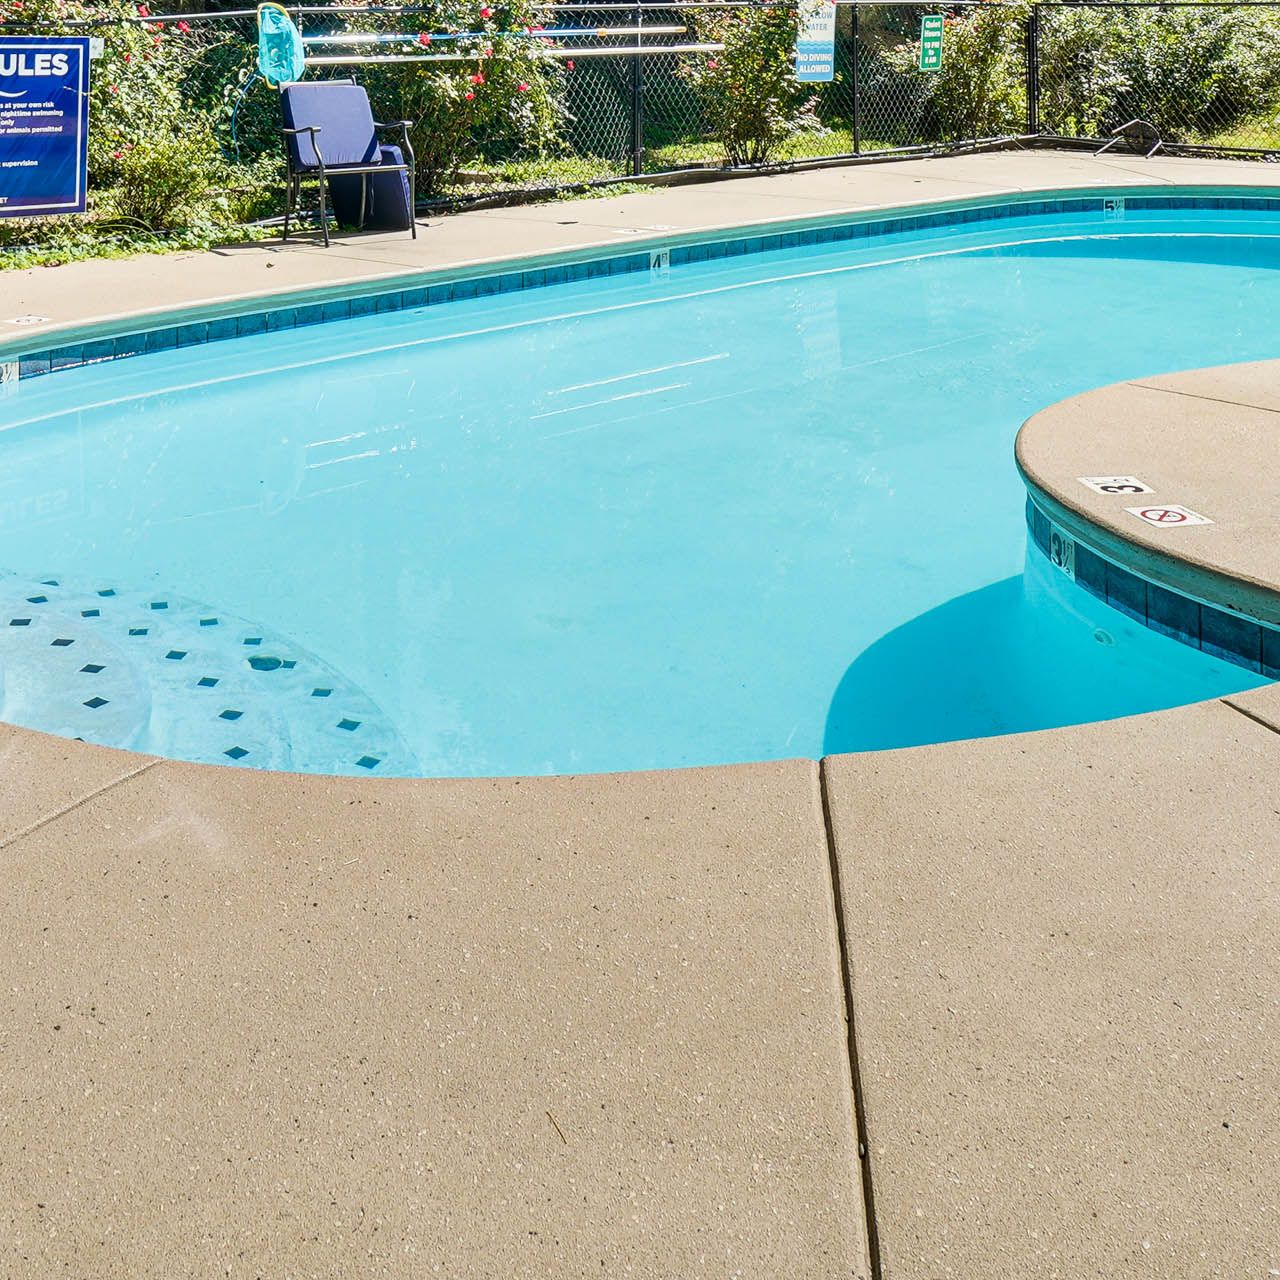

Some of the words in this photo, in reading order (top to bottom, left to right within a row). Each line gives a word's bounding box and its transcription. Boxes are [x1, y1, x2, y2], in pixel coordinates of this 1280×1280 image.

[799, 53, 809, 62] NO
[809, 53, 833, 61] DIVING
[799, 65, 831, 73] ALLOWED
[0, 109, 32, 117] nighttime
[32, 109, 64, 117] swimming
[0, 118, 15, 126] only
[6, 126, 31, 134] animals
[31, 126, 63, 134] permitted
[2, 159, 39, 168] supervision
